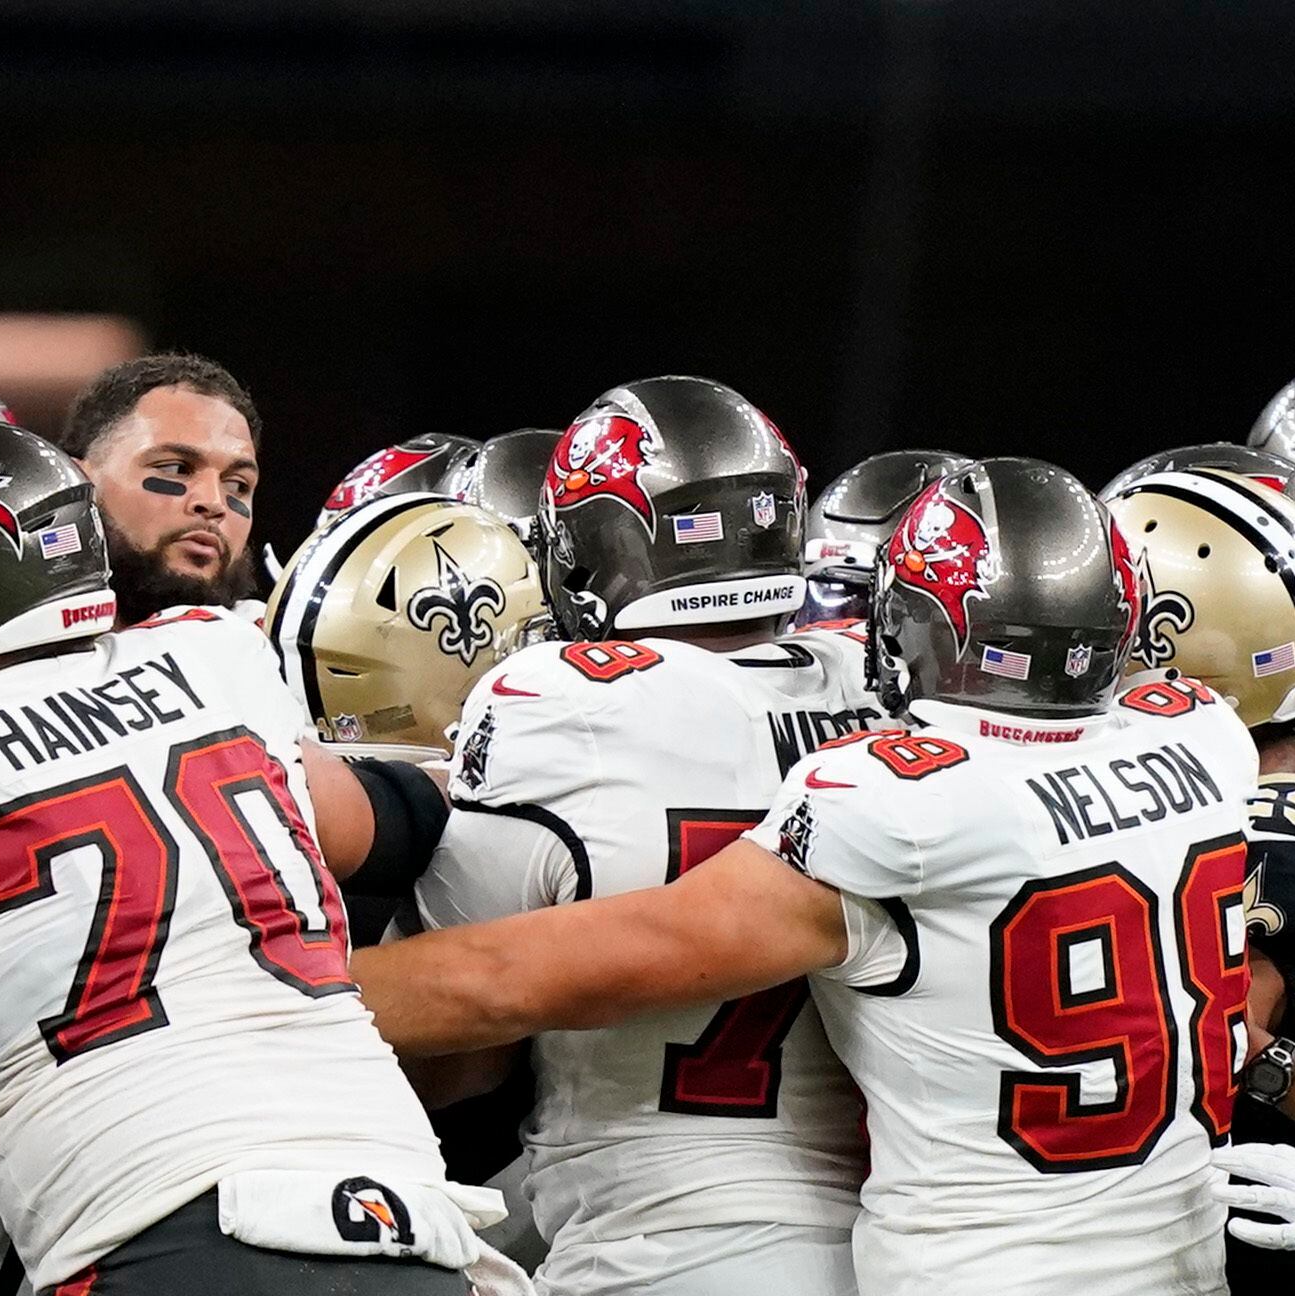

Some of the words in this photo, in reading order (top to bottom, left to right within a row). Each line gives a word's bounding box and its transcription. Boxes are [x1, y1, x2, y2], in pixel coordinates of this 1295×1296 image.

[671, 593, 738, 611] INSPIRE
[744, 586, 795, 604] CHANGE
[979, 719, 1084, 744] BUCCANEERS
[1025, 742, 1224, 846] NELSON
